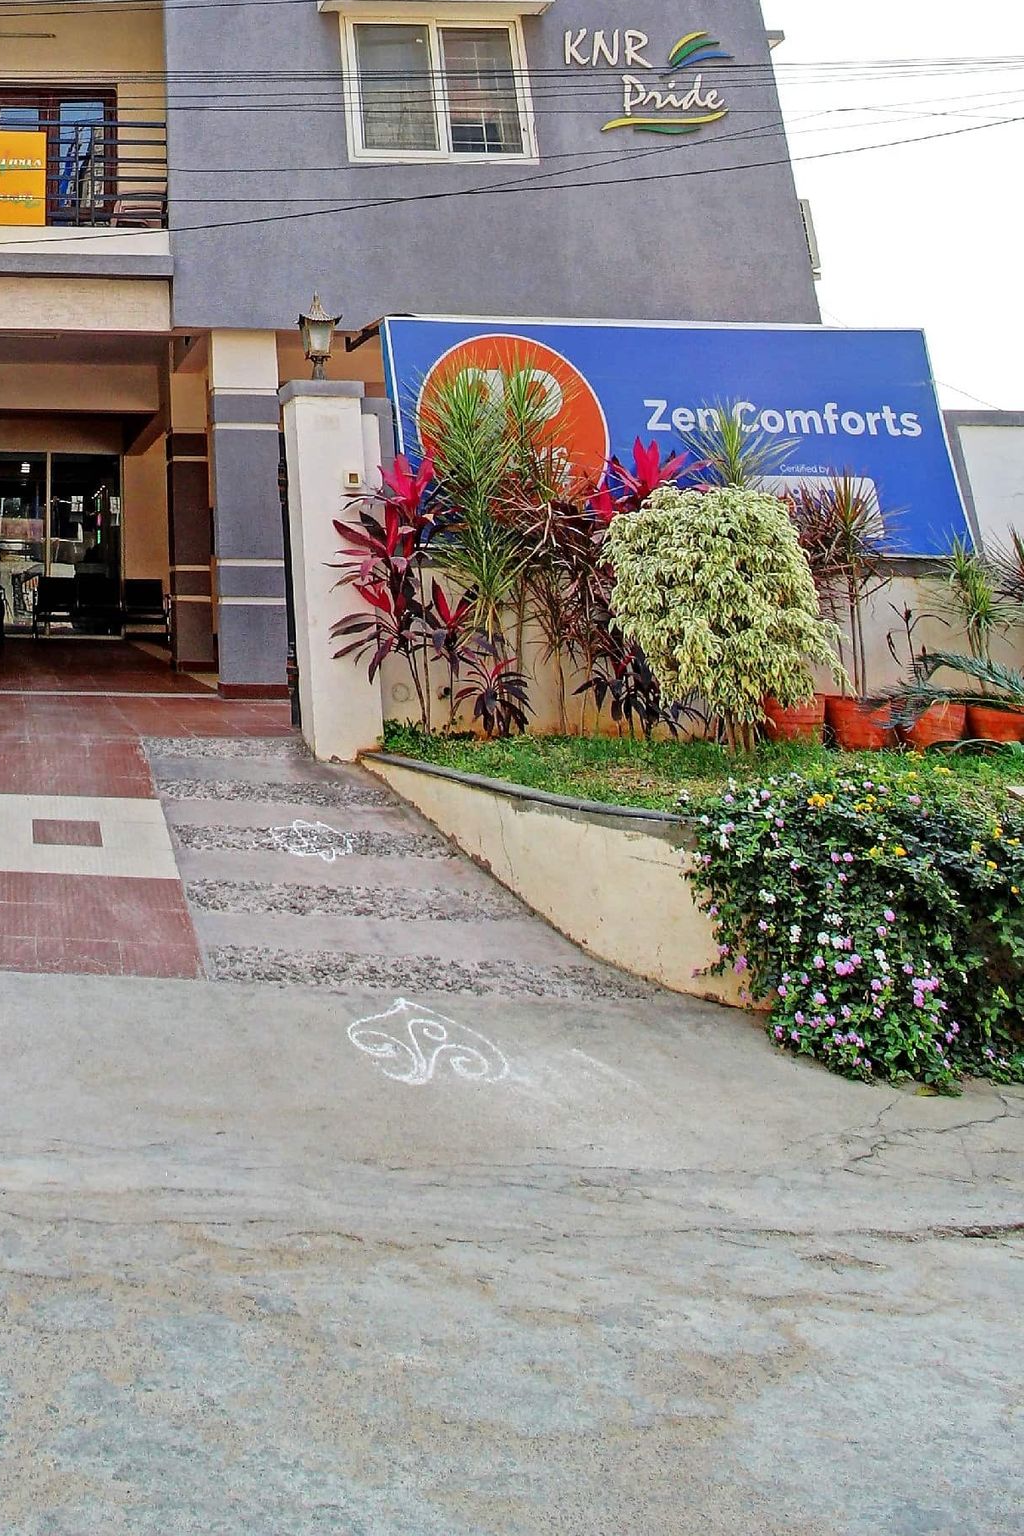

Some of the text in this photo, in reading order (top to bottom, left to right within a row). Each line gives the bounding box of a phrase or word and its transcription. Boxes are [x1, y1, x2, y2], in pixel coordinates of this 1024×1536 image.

[564, 28, 653, 68] KNR
[621, 73, 725, 116] Pride
[643, 399, 923, 437] Zen Comforts
